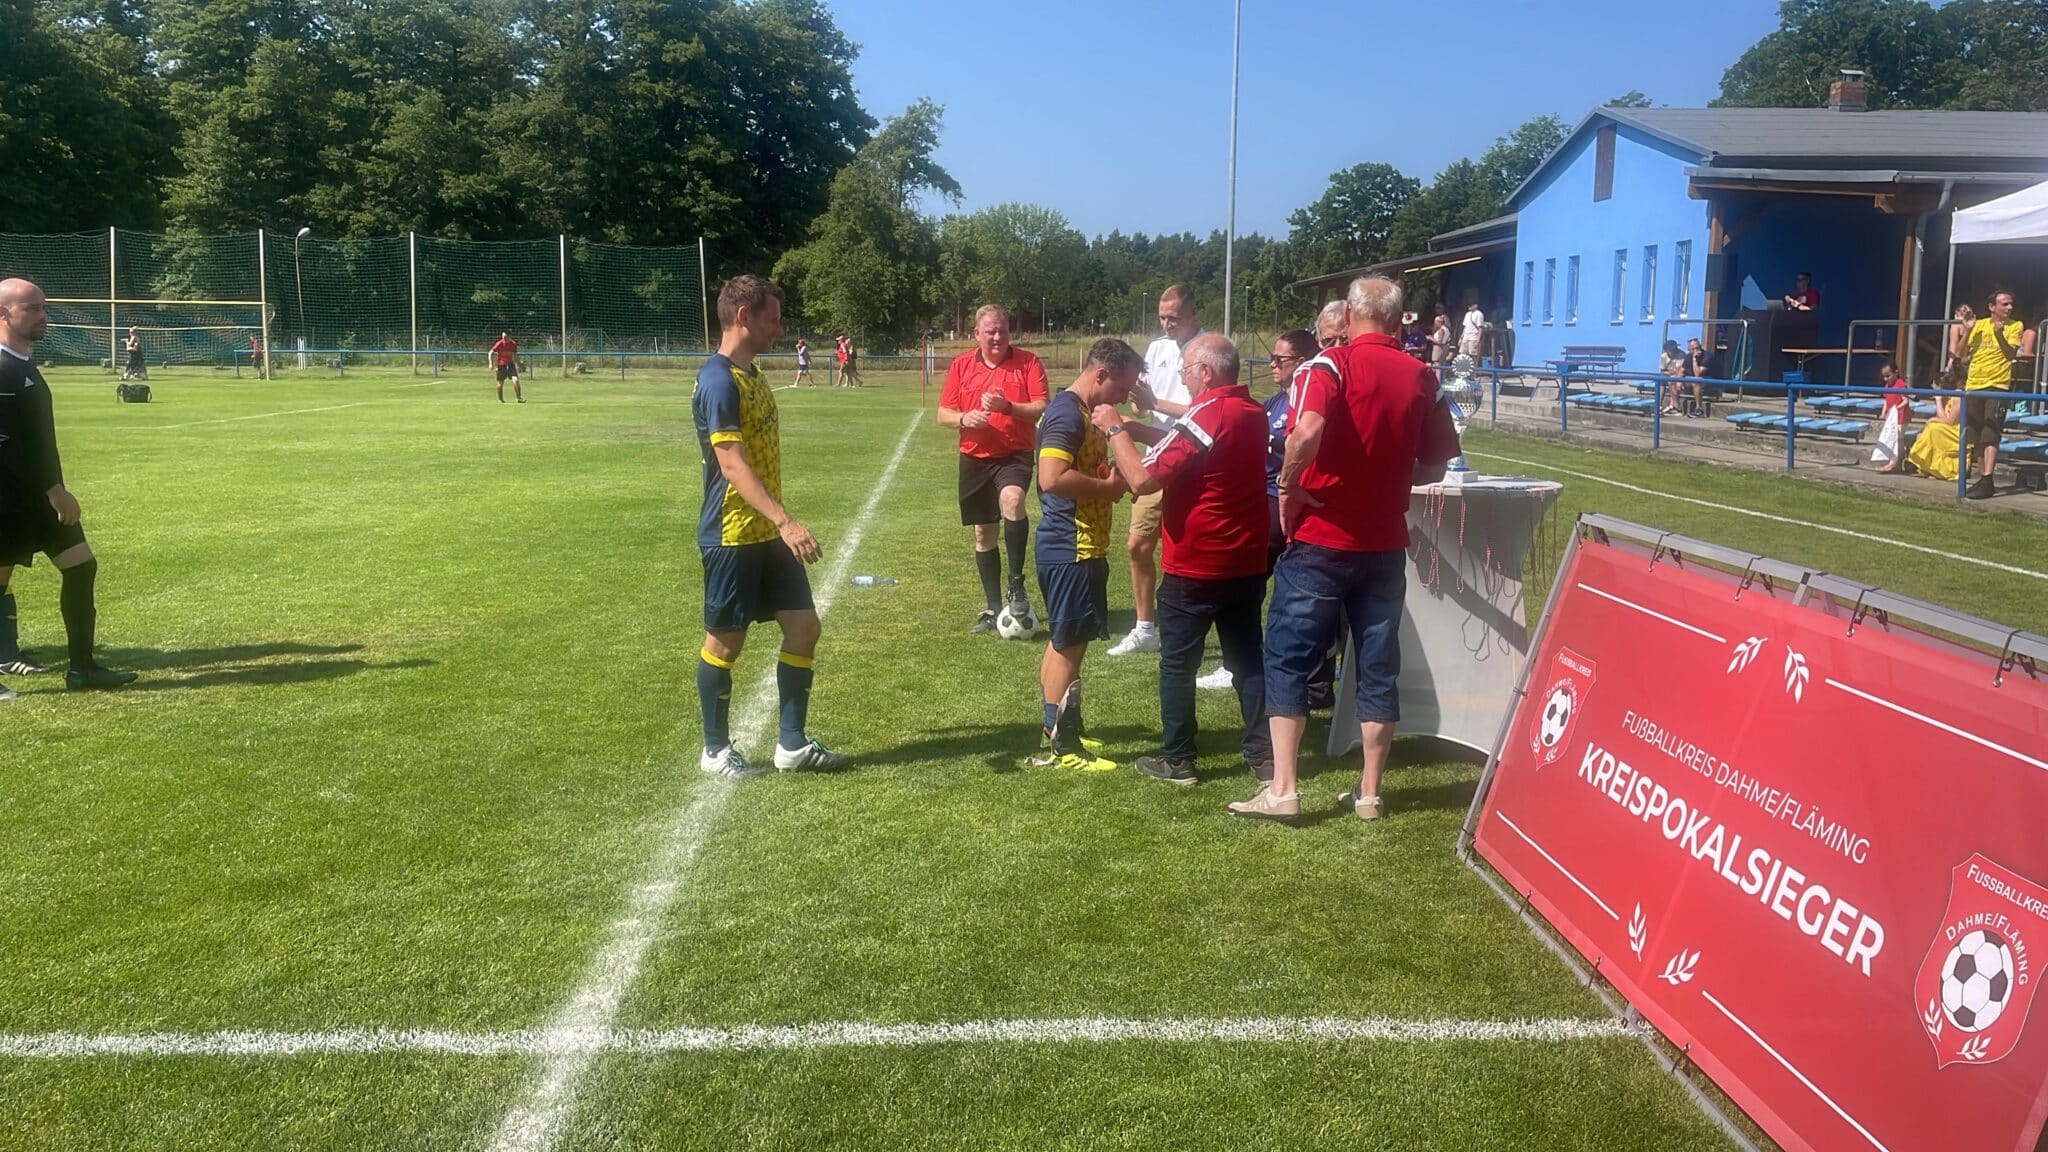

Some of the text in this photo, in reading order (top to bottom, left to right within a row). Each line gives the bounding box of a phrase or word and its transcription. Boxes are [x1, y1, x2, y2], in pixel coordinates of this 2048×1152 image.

[1714, 762, 1871, 864] DAHME/FLÄMING
[1578, 742, 1885, 977] KREISPOKALSIEGER
[1967, 863, 2048, 921] FUSSBALLKRE
[1945, 912, 2029, 986] DAHME/FLÄMING
